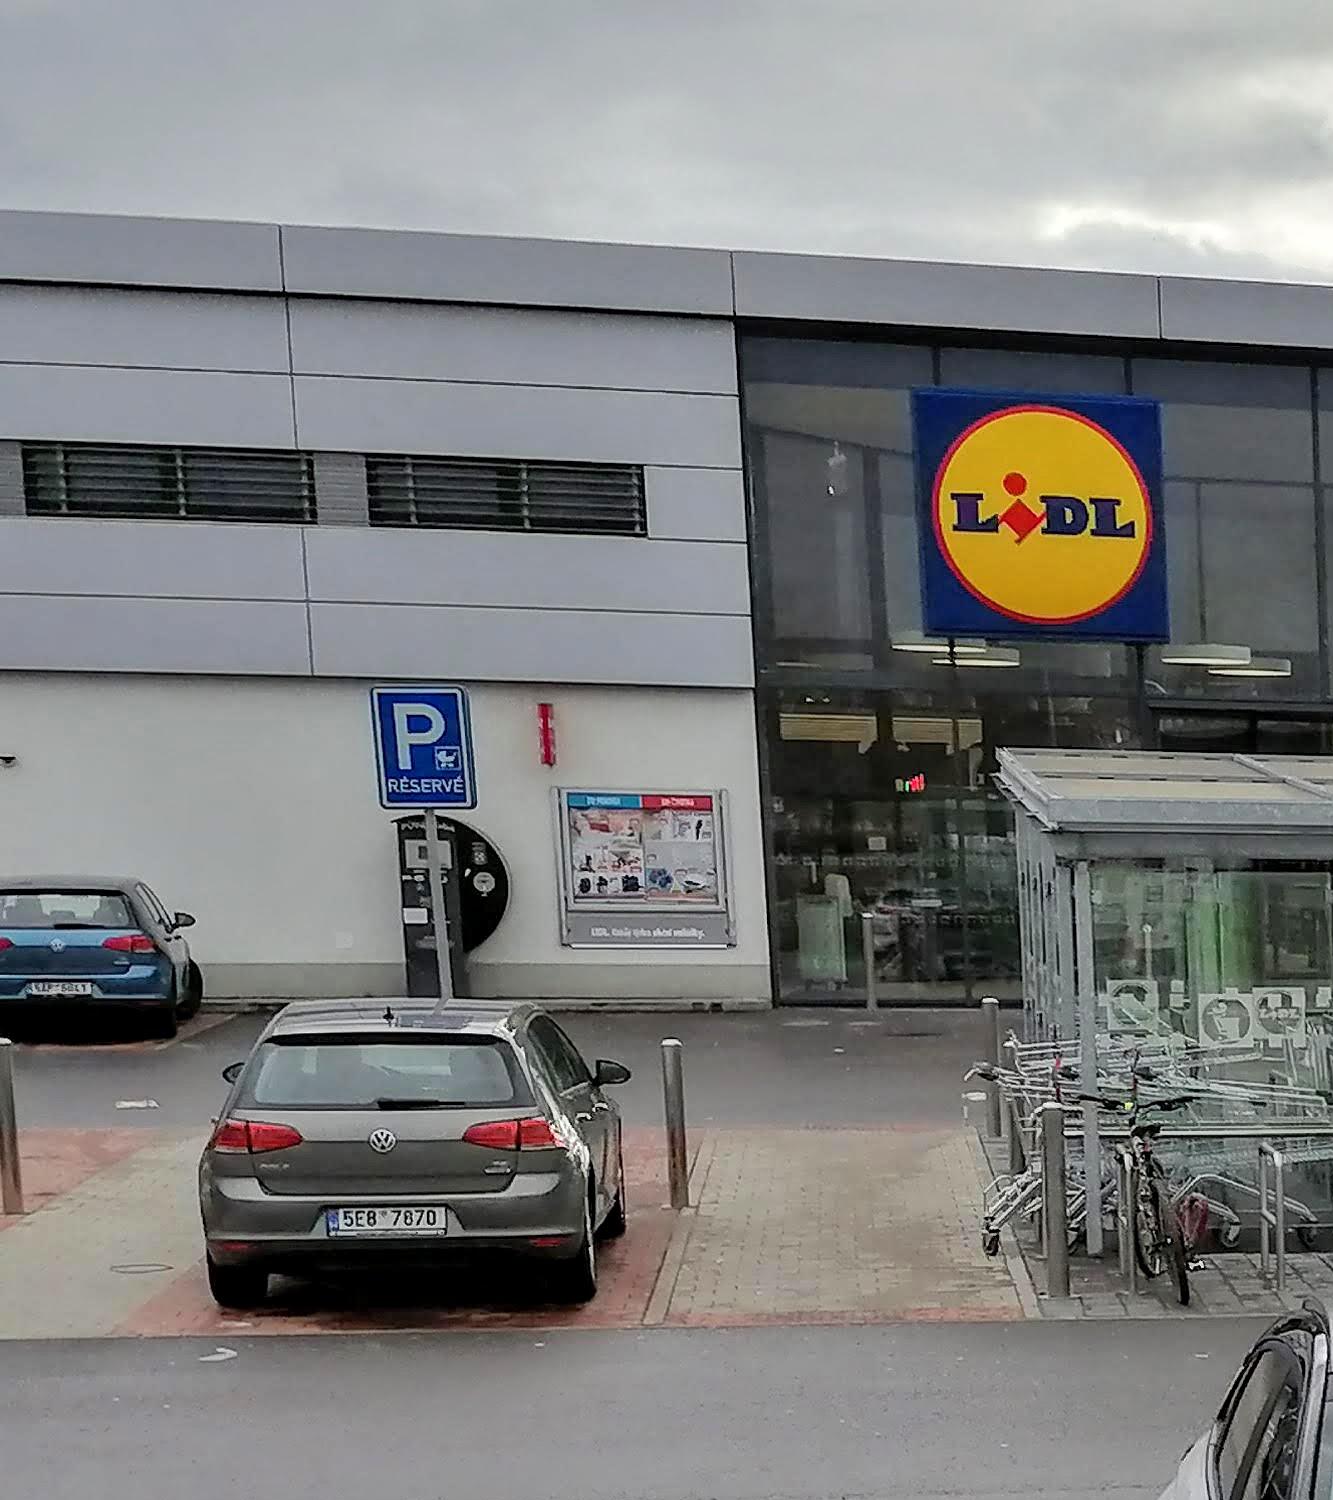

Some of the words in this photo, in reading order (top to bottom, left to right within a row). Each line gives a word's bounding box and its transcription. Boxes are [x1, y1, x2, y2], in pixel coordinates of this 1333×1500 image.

[950, 472, 1136, 545] LIDL
[393, 703, 446, 770] P
[387, 776, 465, 793] RÉSERVÉ
[343, 1210, 377, 1227] 5E8
